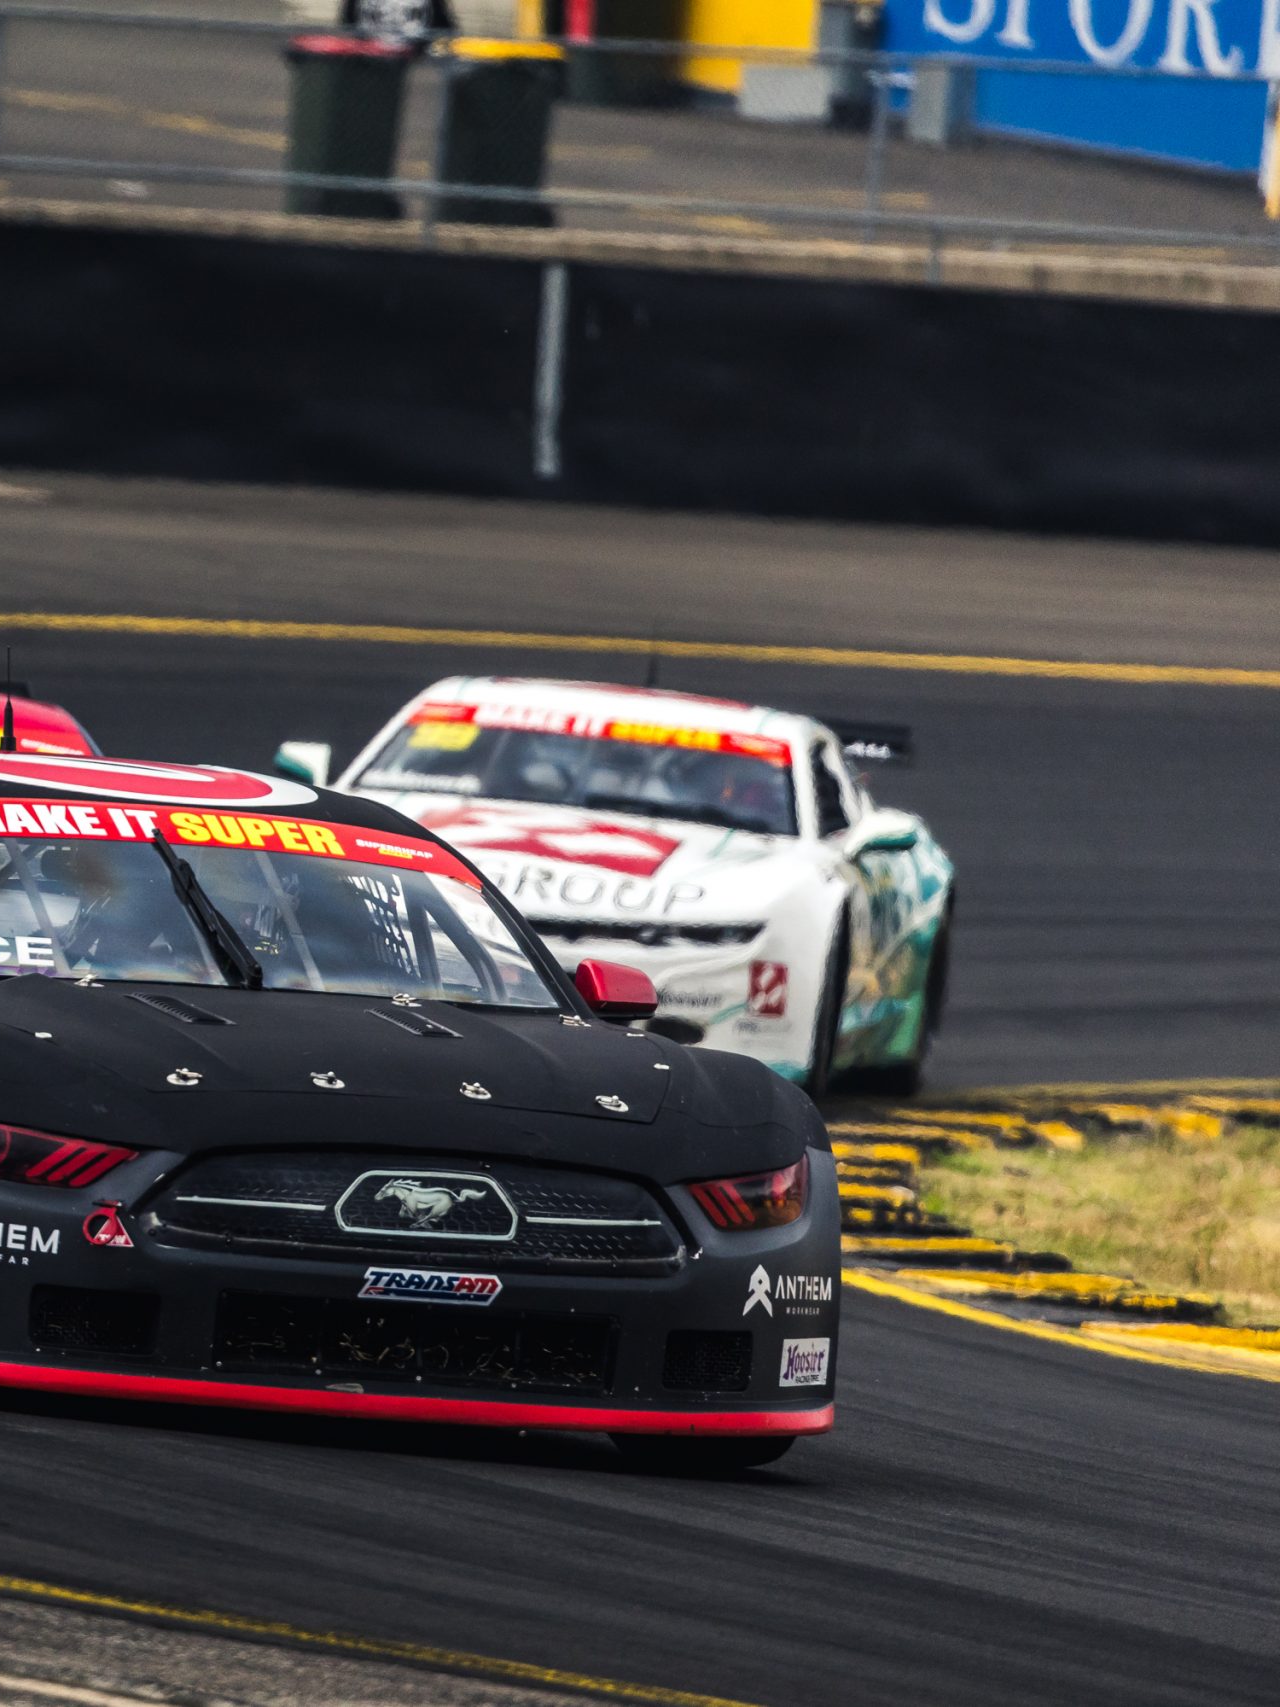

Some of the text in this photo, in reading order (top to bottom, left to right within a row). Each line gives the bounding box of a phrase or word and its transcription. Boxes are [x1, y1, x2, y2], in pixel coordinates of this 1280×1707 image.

[110, 808, 158, 838] IT
[170, 812, 344, 856] SUPER
[775, 1275, 832, 1301] ANTHEM
